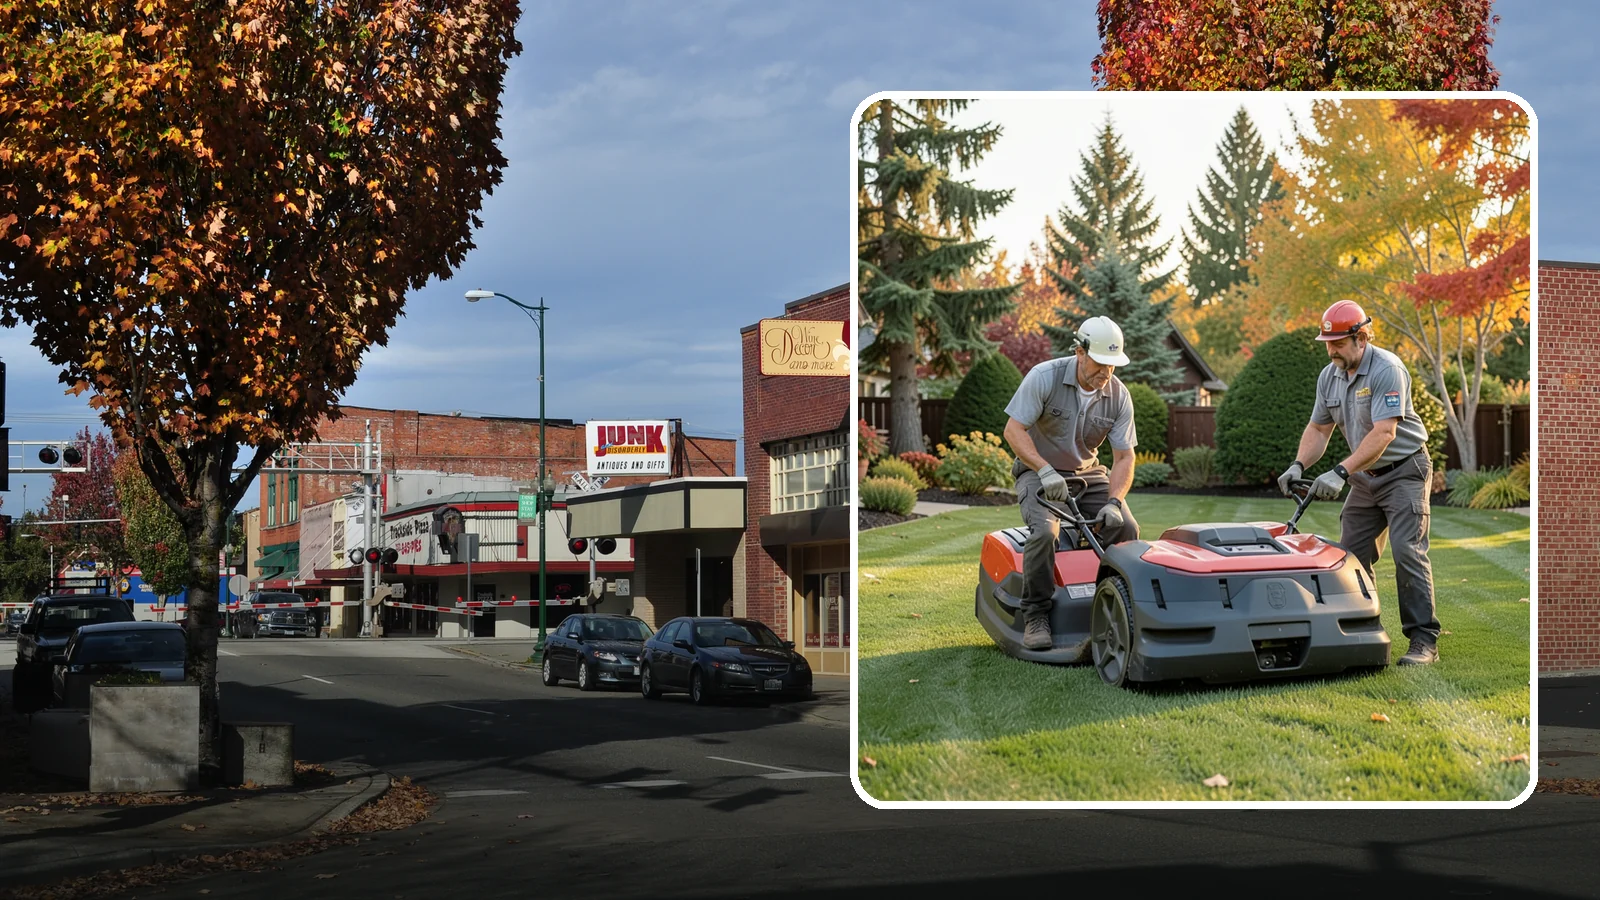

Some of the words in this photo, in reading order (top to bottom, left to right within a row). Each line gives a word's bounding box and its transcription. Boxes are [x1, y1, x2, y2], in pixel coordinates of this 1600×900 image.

[765, 327, 831, 365] Decor
[596, 425, 665, 457] JUNK
[607, 446, 645, 454] DISORDERLY
[597, 461, 628, 470] ANTIQUES
[631, 461, 643, 470] AND
[647, 461, 665, 469] GIFTS
[573, 473, 588, 490] RAIL
[415, 519, 429, 534] Pizza
